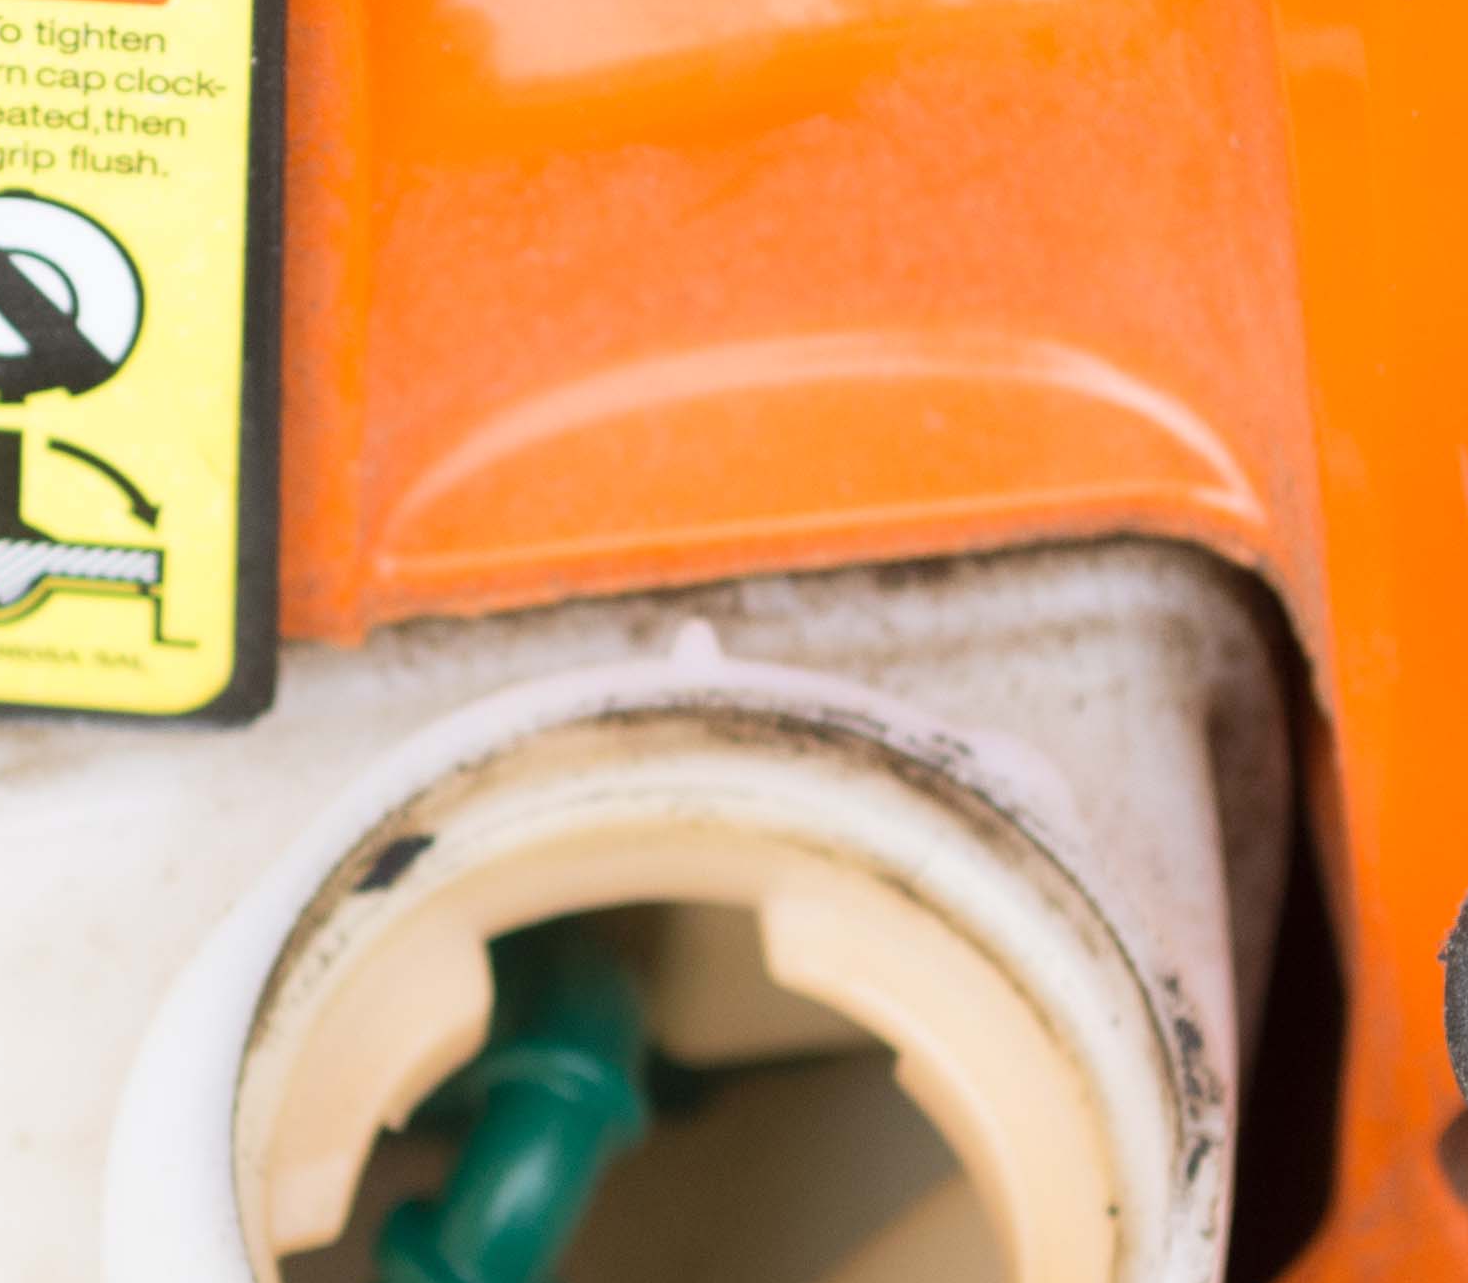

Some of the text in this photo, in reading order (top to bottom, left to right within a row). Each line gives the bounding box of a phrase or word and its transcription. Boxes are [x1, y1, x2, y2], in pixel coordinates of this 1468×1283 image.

[36, 19, 167, 54] tighten
[36, 66, 106, 96] cap
[115, 67, 226, 98] clock-
[70, 144, 169, 178] flush.
